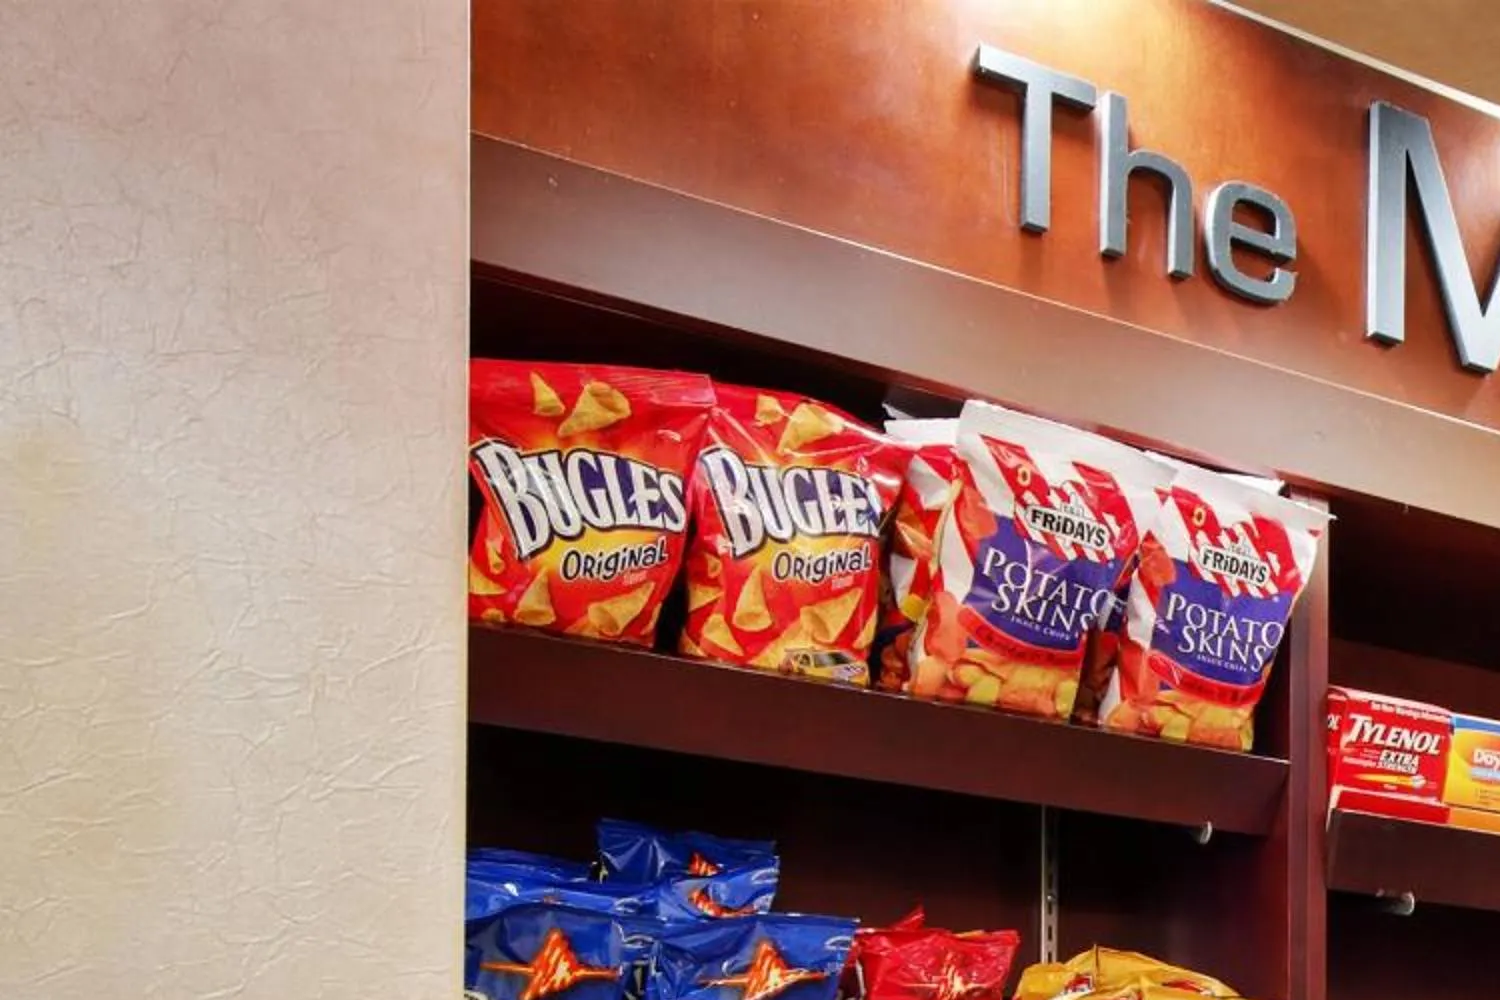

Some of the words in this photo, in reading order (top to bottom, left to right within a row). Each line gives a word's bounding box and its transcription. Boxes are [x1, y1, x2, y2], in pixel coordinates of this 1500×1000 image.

[974, 43, 1298, 303] The
[470, 437, 689, 561] BUGLES
[1165, 592, 1285, 649] POTATO
[1177, 625, 1267, 673] SKINS
[1342, 712, 1442, 757] TYLENOL
